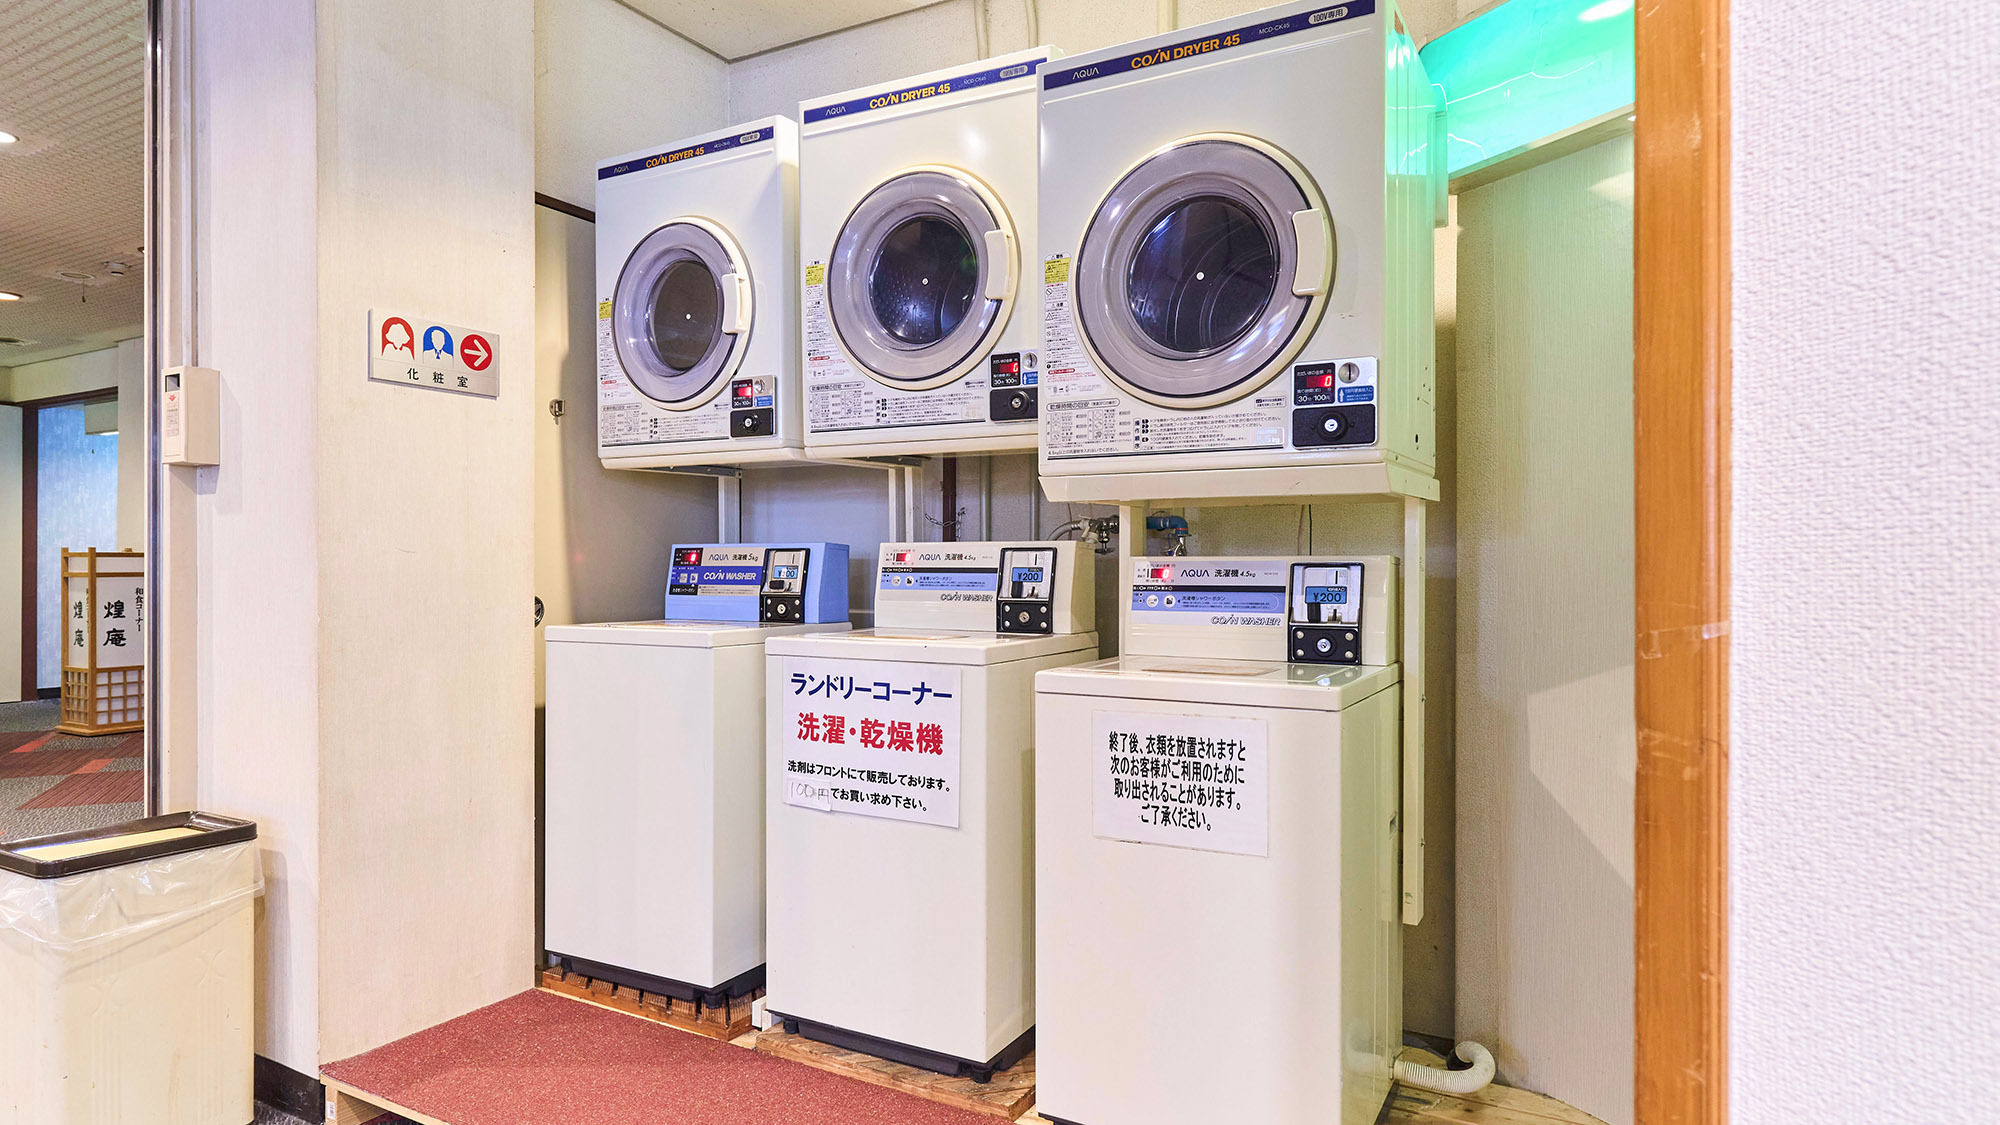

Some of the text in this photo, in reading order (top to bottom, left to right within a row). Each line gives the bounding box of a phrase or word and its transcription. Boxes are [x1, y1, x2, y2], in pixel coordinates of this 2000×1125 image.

[1312, 8, 1344, 23] 100V専用
[1072, 67, 1099, 81] AQUA
[1173, 39, 1220, 60] DRYER
[1223, 33, 1241, 47] 45
[825, 105, 846, 116] AQUA
[901, 85, 937, 103] DRYER
[937, 82, 951, 95] 45
[613, 165, 629, 174] AQUA
[668, 148, 694, 163] DRYER
[694, 146, 705, 156] 45
[406, 367, 469, 389] 化粧室
[1324, 374, 1334, 388] 0
[708, 553, 729, 561] AQUA
[919, 553, 941, 561] AQUA
[944, 552, 963, 561] 洗濯機
[725, 572, 757, 580] WASHER
[1017, 572, 1039, 581] ¥200
[1163, 568, 1170, 579] 0
[1180, 569, 1210, 578] AQUA
[1214, 568, 1239, 578] 洗濯機
[135, 587, 144, 632] 和食コーナー
[962, 593, 994, 602] WASHER
[1313, 592, 1342, 603] ¥200
[103, 599, 127, 647] 煌庵
[1240, 616, 1281, 626] WASHER
[790, 672, 953, 706] ランドリーコーナー
[796, 711, 944, 756] 洗濯・乾燥機
[1108, 730, 1247, 762] 終了後、衣類を放置されますと
[787, 759, 951, 792] 洗剤はフロントにて販売しております。
[1110, 754, 1246, 785] 次のお客様がご利用のために
[830, 788, 928, 812] でお買い求め下さい。
[1113, 777, 1241, 811] 取り出されることがあります。
[1140, 802, 1212, 832] ご了承ください。
